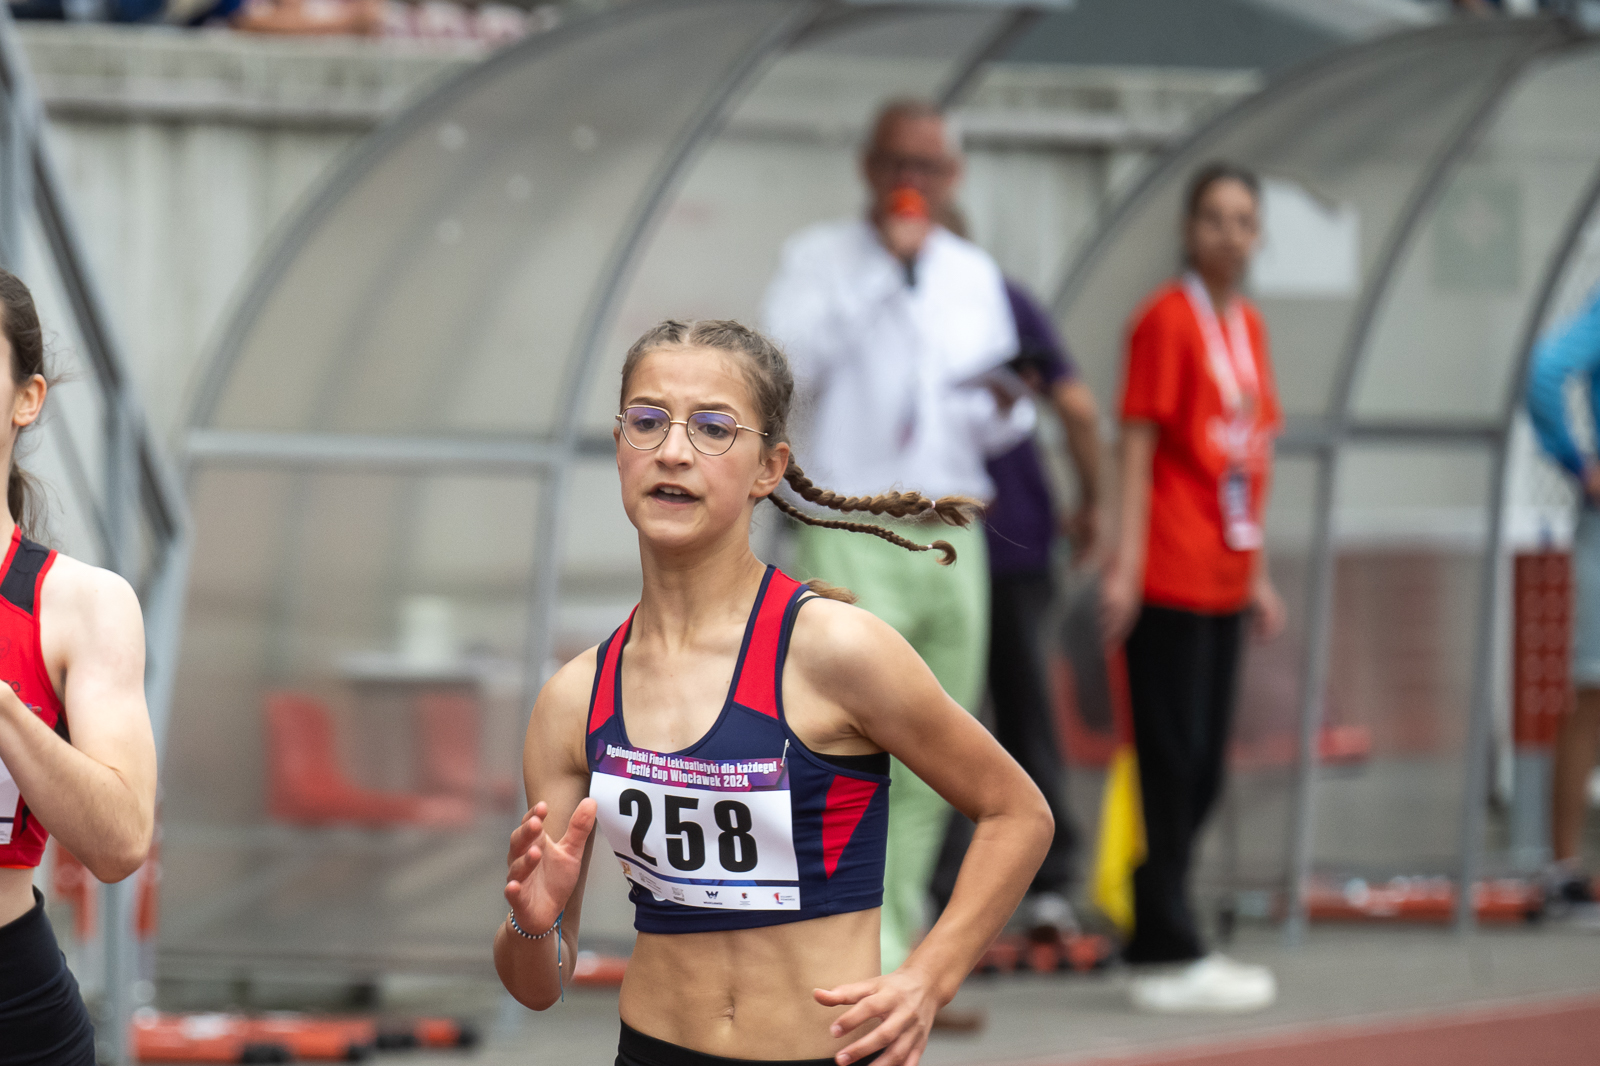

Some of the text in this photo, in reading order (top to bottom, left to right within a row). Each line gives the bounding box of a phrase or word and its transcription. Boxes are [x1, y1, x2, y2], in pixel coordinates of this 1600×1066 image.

[606, 744, 778, 775] Ogólnopolski Finał Lekkoatletyki dla każdego!
[626, 760, 749, 788] Nestlé Cup Włocławek 2024
[619, 788, 758, 872] 258
